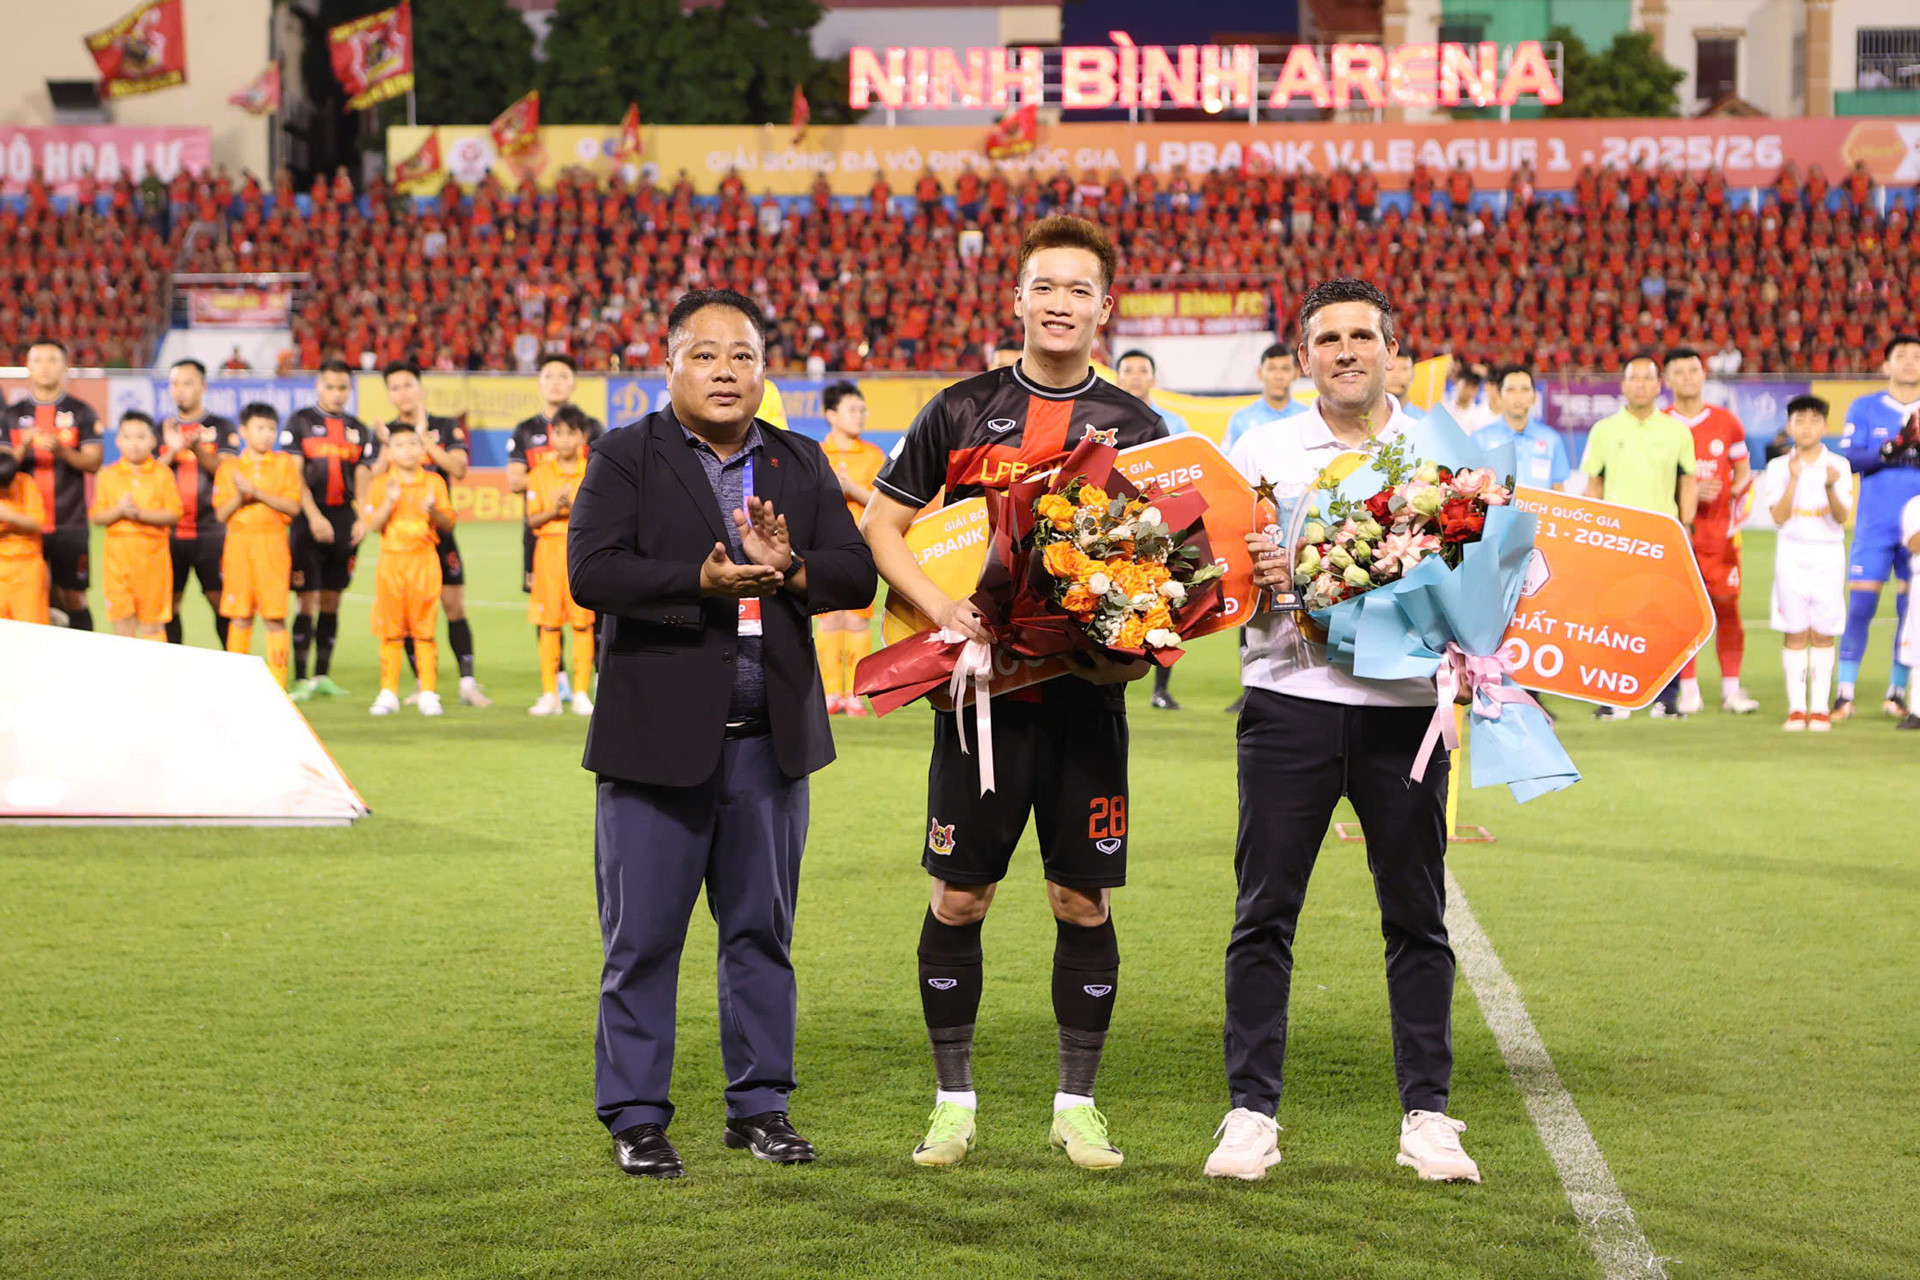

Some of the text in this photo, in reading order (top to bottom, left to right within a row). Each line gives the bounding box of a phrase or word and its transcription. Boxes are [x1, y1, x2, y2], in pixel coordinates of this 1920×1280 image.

[849, 30, 1563, 110] NINH BÌNH ARENA
[0, 133, 32, 183] Ô
[44, 141, 120, 185] HOA
[1075, 148, 1121, 170] GIA
[1134, 140, 1316, 173] LPBANK
[1324, 138, 1537, 172] V.LEAGUE
[1546, 138, 1570, 171] 1
[1600, 135, 1783, 171] 2025/26
[1236, 291, 1264, 317] FC
[1130, 460, 1154, 475] GIA
[944, 507, 987, 532] GIẢI BÓ
[1551, 505, 1593, 523] QUỐC
[1596, 515, 1621, 529] GIA
[914, 527, 986, 565] LPBANK
[1546, 522, 1557, 538] 1
[1574, 528, 1664, 560] 2025/26
[1510, 610, 1646, 654] HẤT THÁNG
[1503, 637, 1639, 695] 00 VNĐ
[1089, 795, 1126, 838] 28
